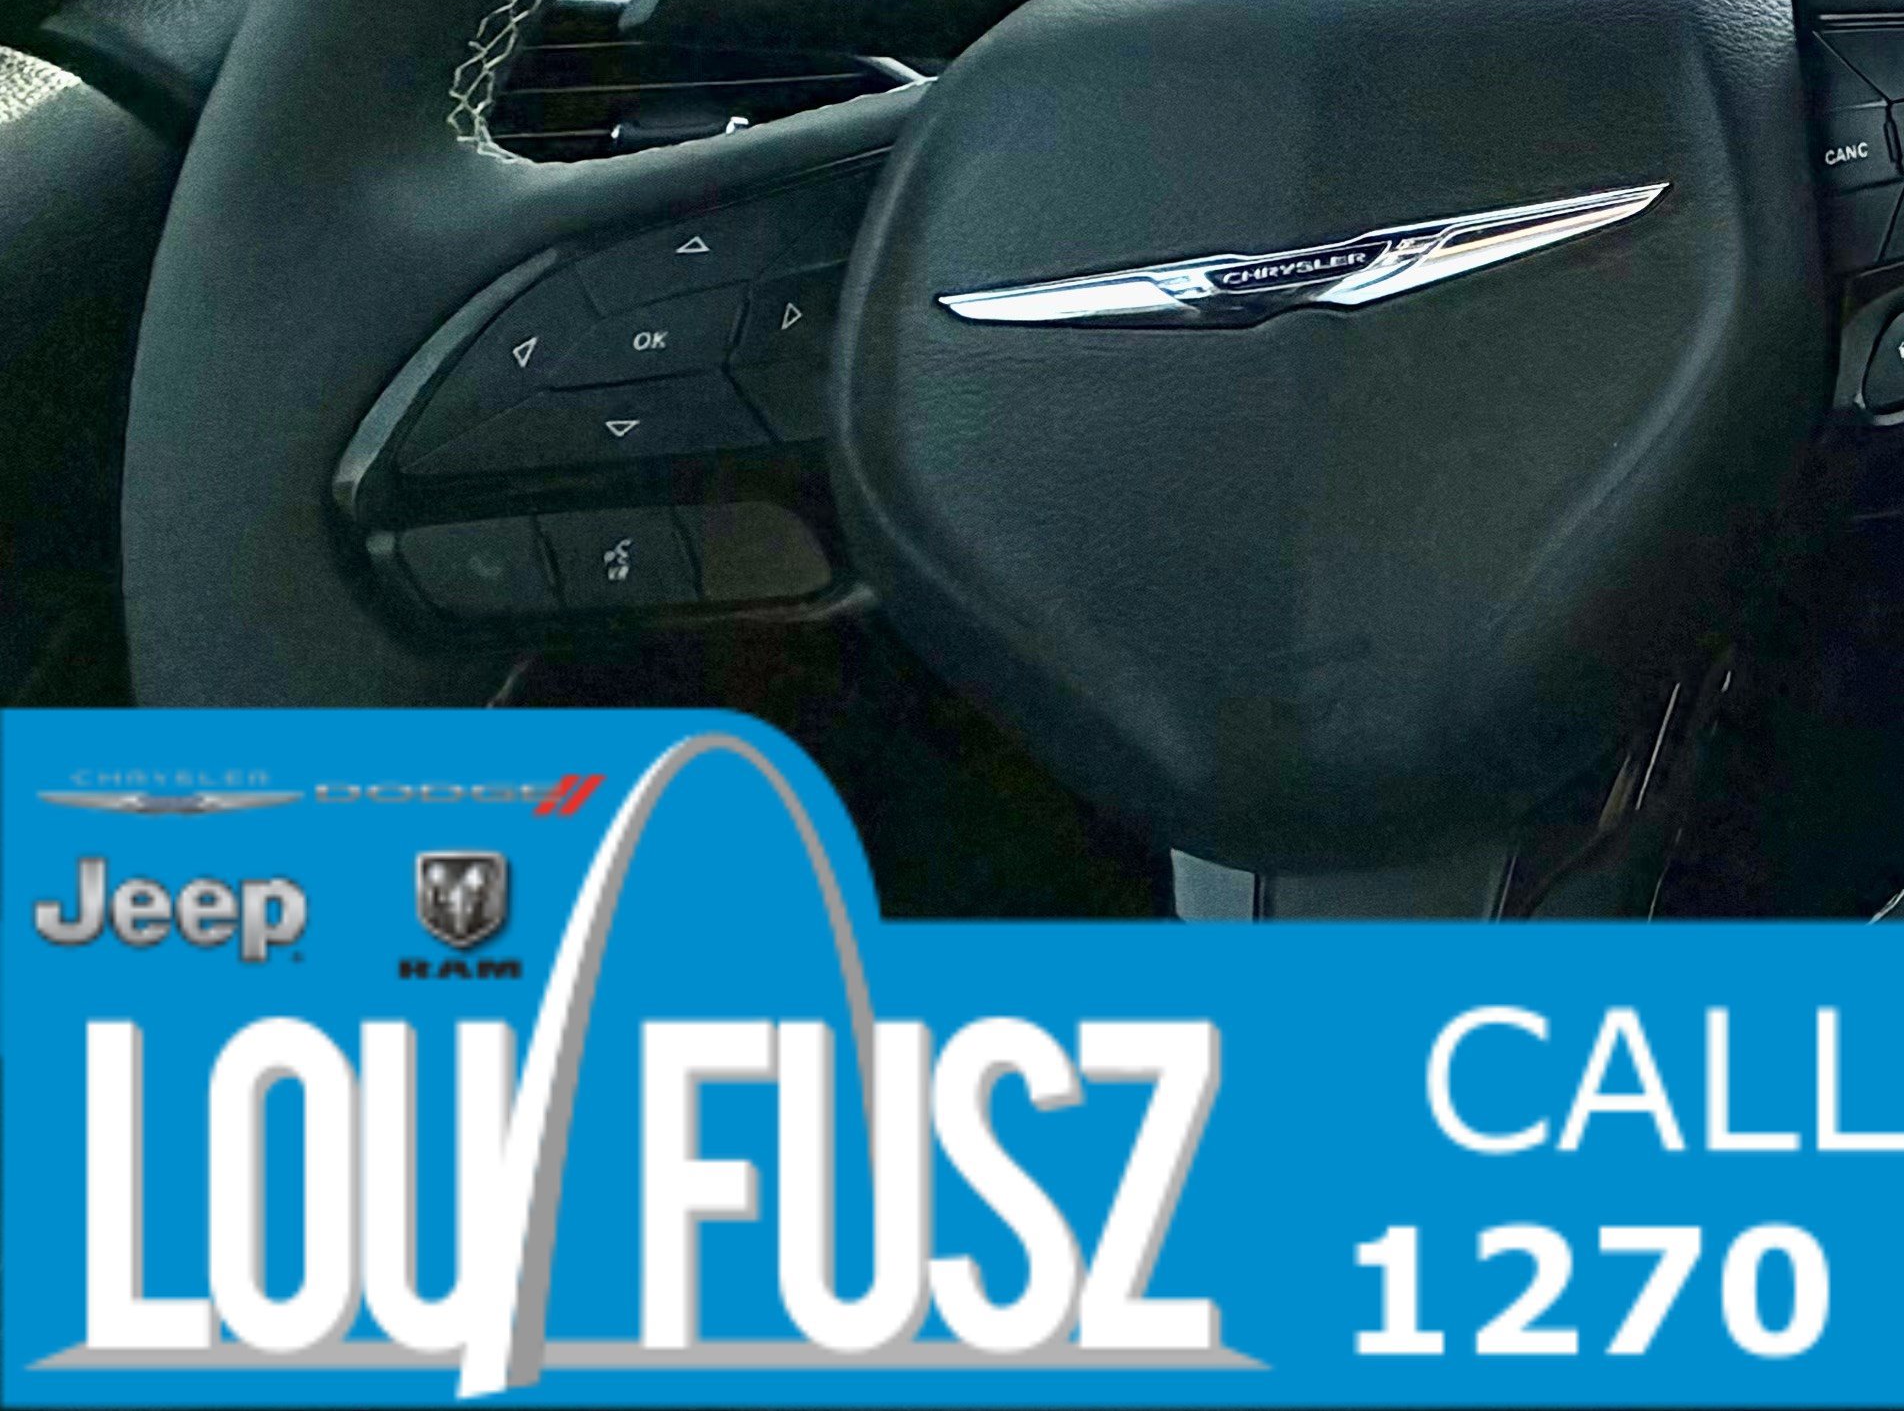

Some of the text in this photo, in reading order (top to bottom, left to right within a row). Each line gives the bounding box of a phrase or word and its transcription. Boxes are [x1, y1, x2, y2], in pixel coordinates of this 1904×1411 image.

[1825, 141, 1868, 165] CANC
[1222, 251, 1368, 285] CHRYSLER
[633, 332, 667, 351] OK
